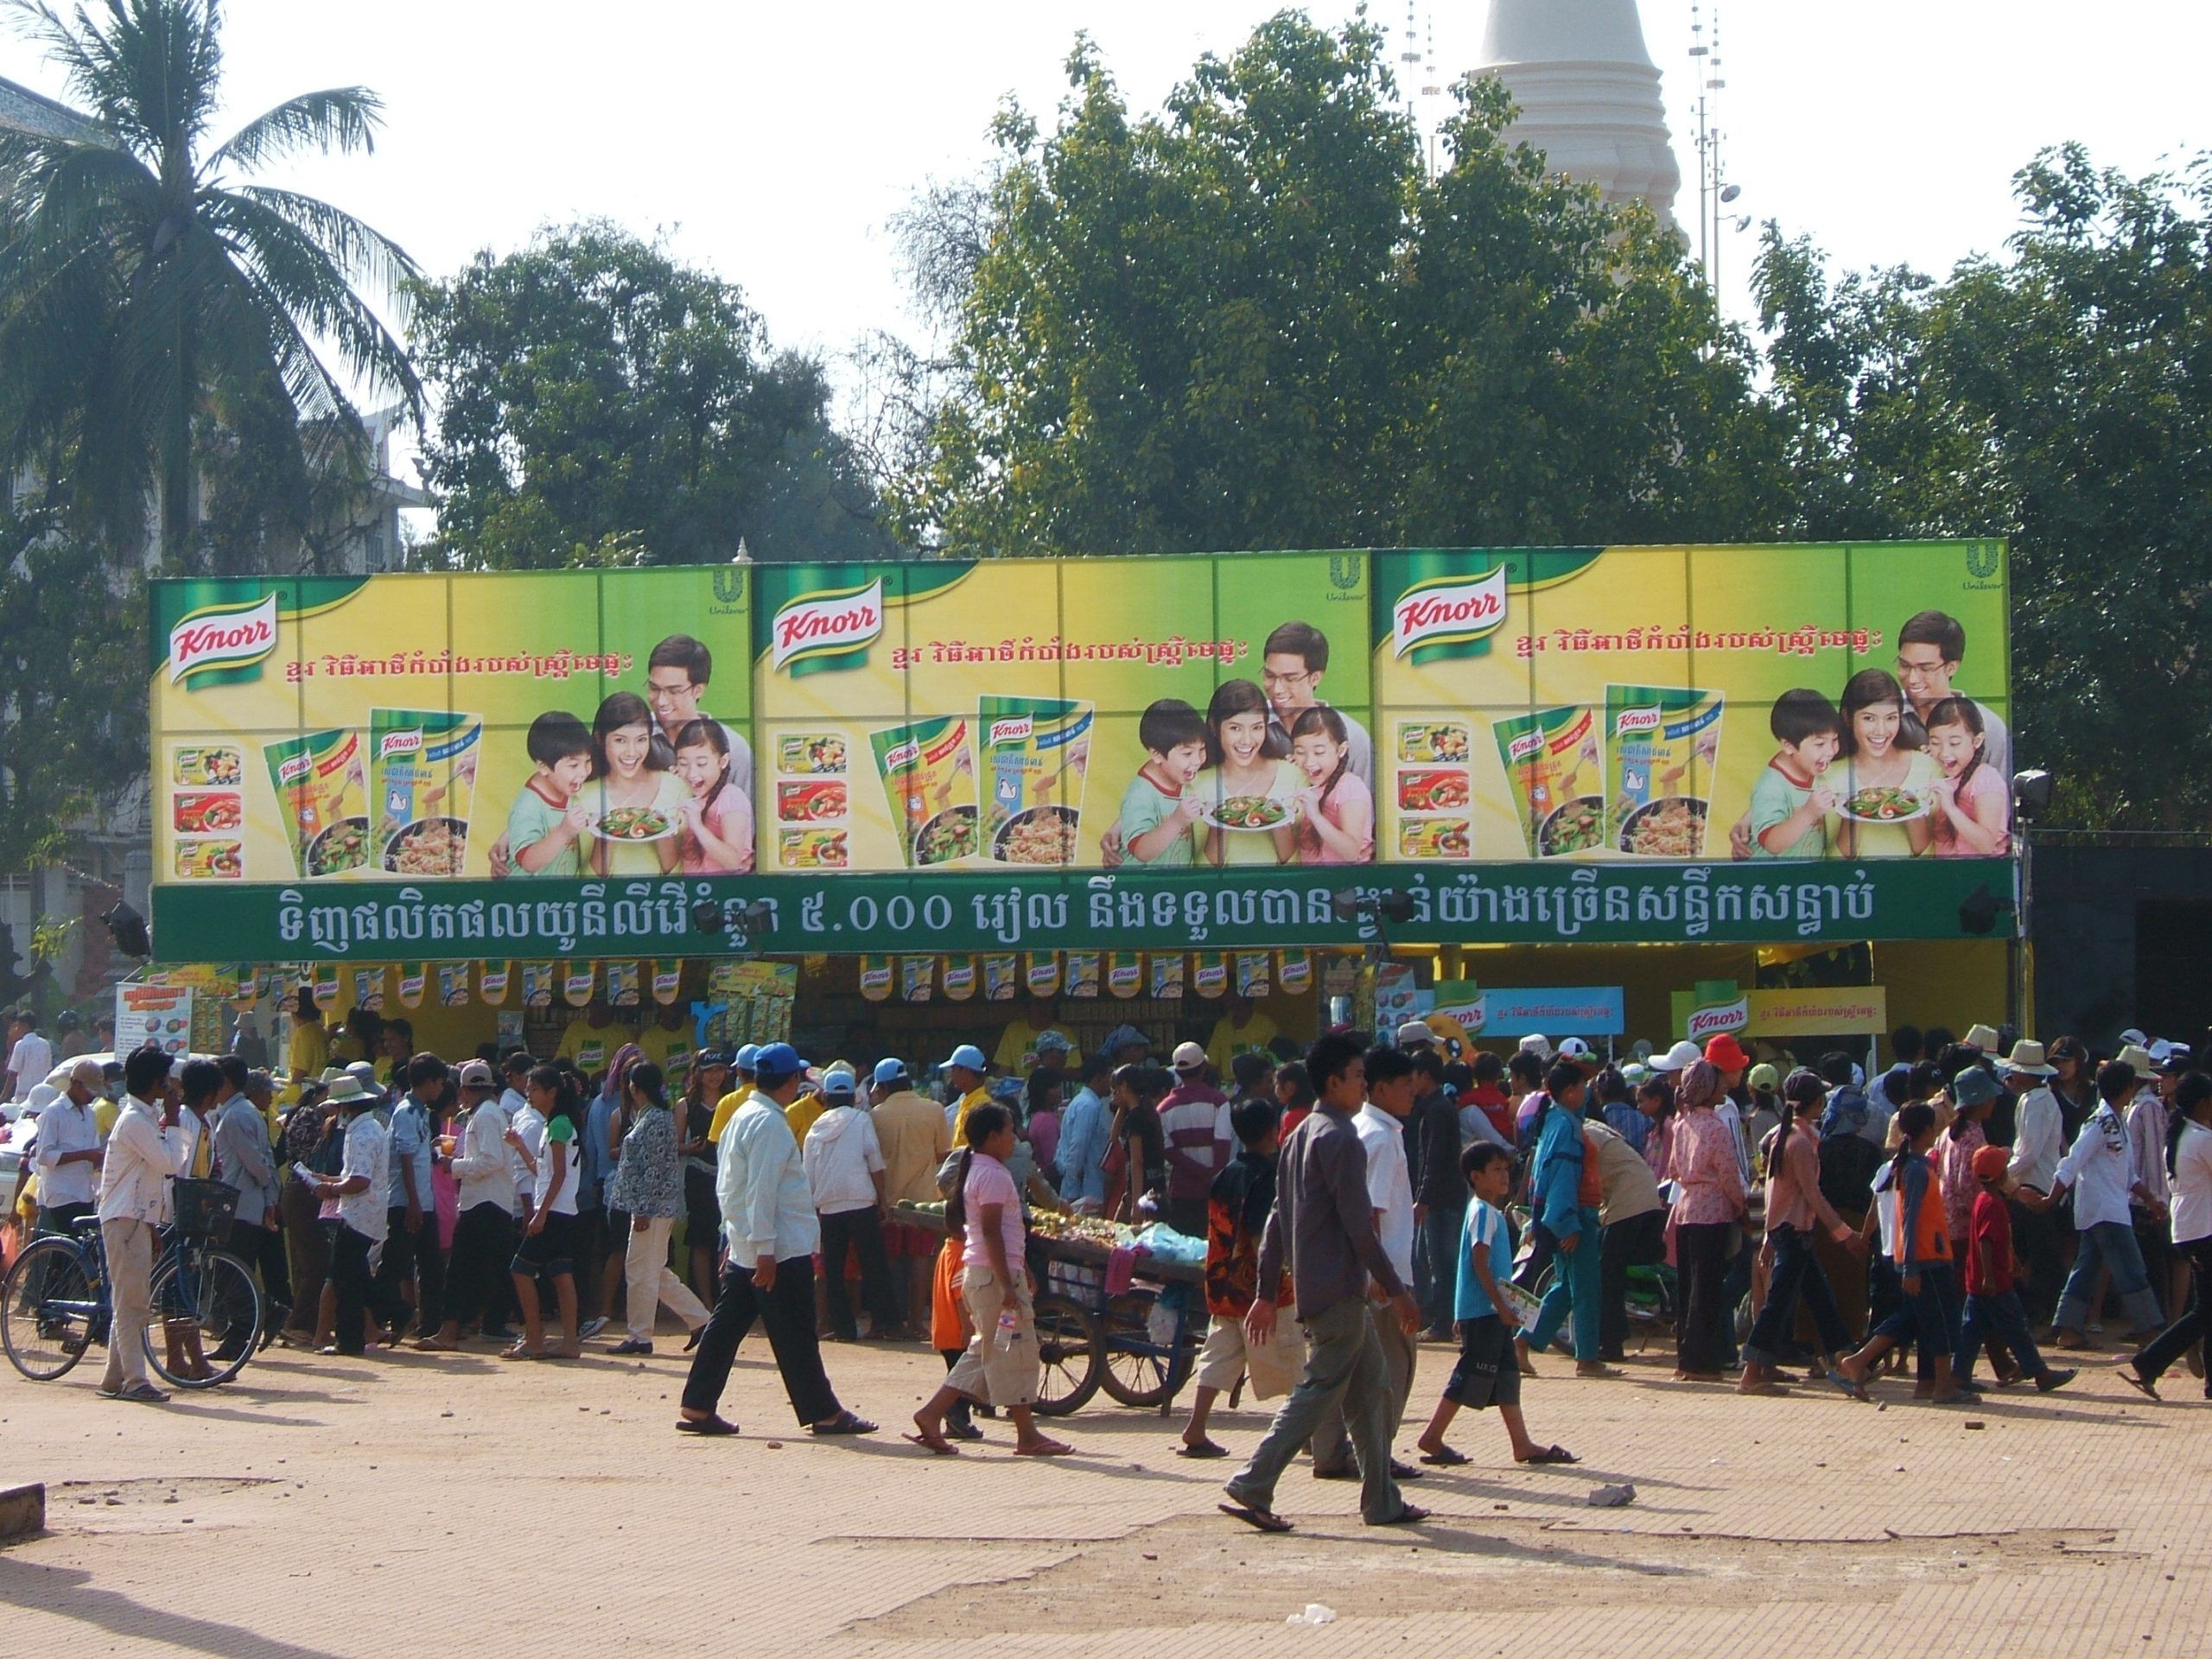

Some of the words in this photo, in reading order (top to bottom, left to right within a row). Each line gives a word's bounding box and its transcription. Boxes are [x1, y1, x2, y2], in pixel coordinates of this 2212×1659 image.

[1397, 593, 1500, 635] Knorr
[777, 606, 876, 648] Knorr
[174, 620, 271, 662] Knorr
[1618, 711, 1659, 729] Knorr
[992, 723, 1030, 739] Knorr
[383, 735, 421, 751] Knorr
[1510, 735, 1542, 756] Knorr
[887, 746, 918, 767] Knorr
[280, 758, 311, 779] Knorr
[1444, 1008, 1483, 1024] orr
[1689, 1008, 1745, 1033] Knorr
